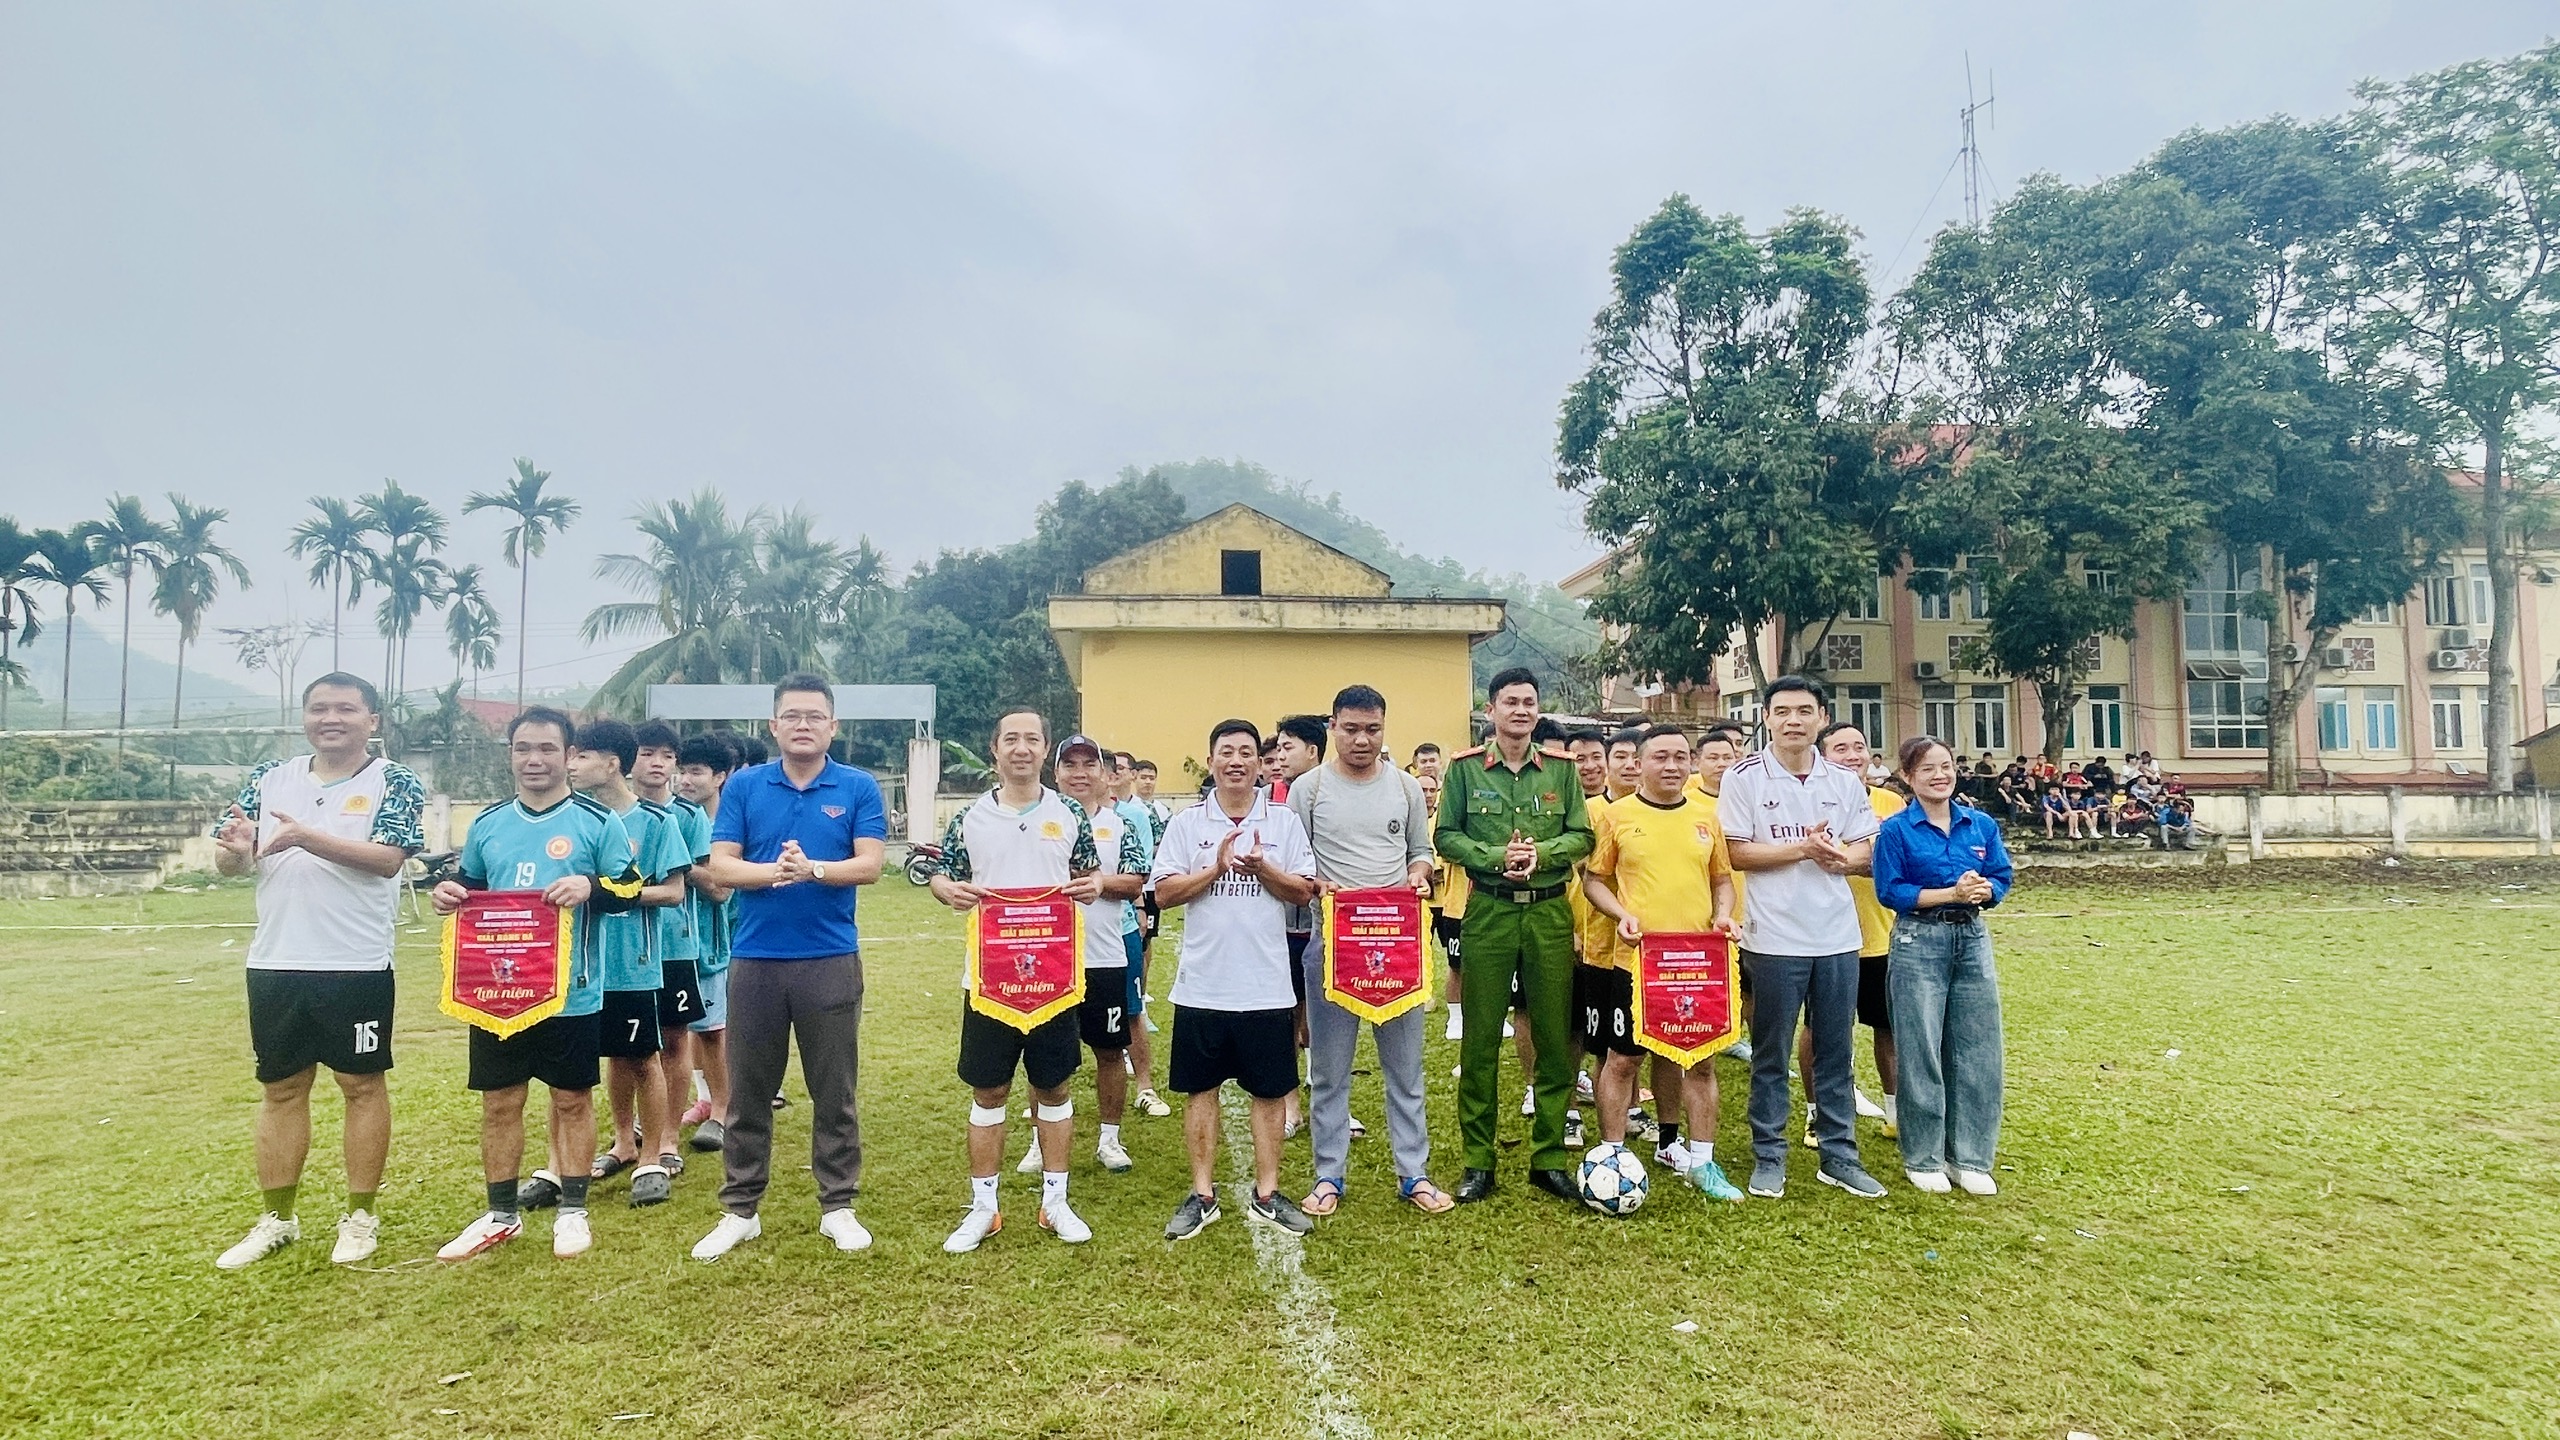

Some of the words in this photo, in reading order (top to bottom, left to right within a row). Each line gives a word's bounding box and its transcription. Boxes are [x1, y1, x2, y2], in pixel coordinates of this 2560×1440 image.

[1770, 822, 1834, 840] Emirs
[514, 861, 536, 888] 19
[1228, 883, 1262, 897] BETTER
[1448, 937, 1460, 956] 02
[676, 989, 689, 1012] 2
[627, 1018, 640, 1042] 7
[1106, 1006, 1122, 1033] 12
[1613, 1007, 1626, 1037] 8
[354, 1020, 379, 1054] 16
